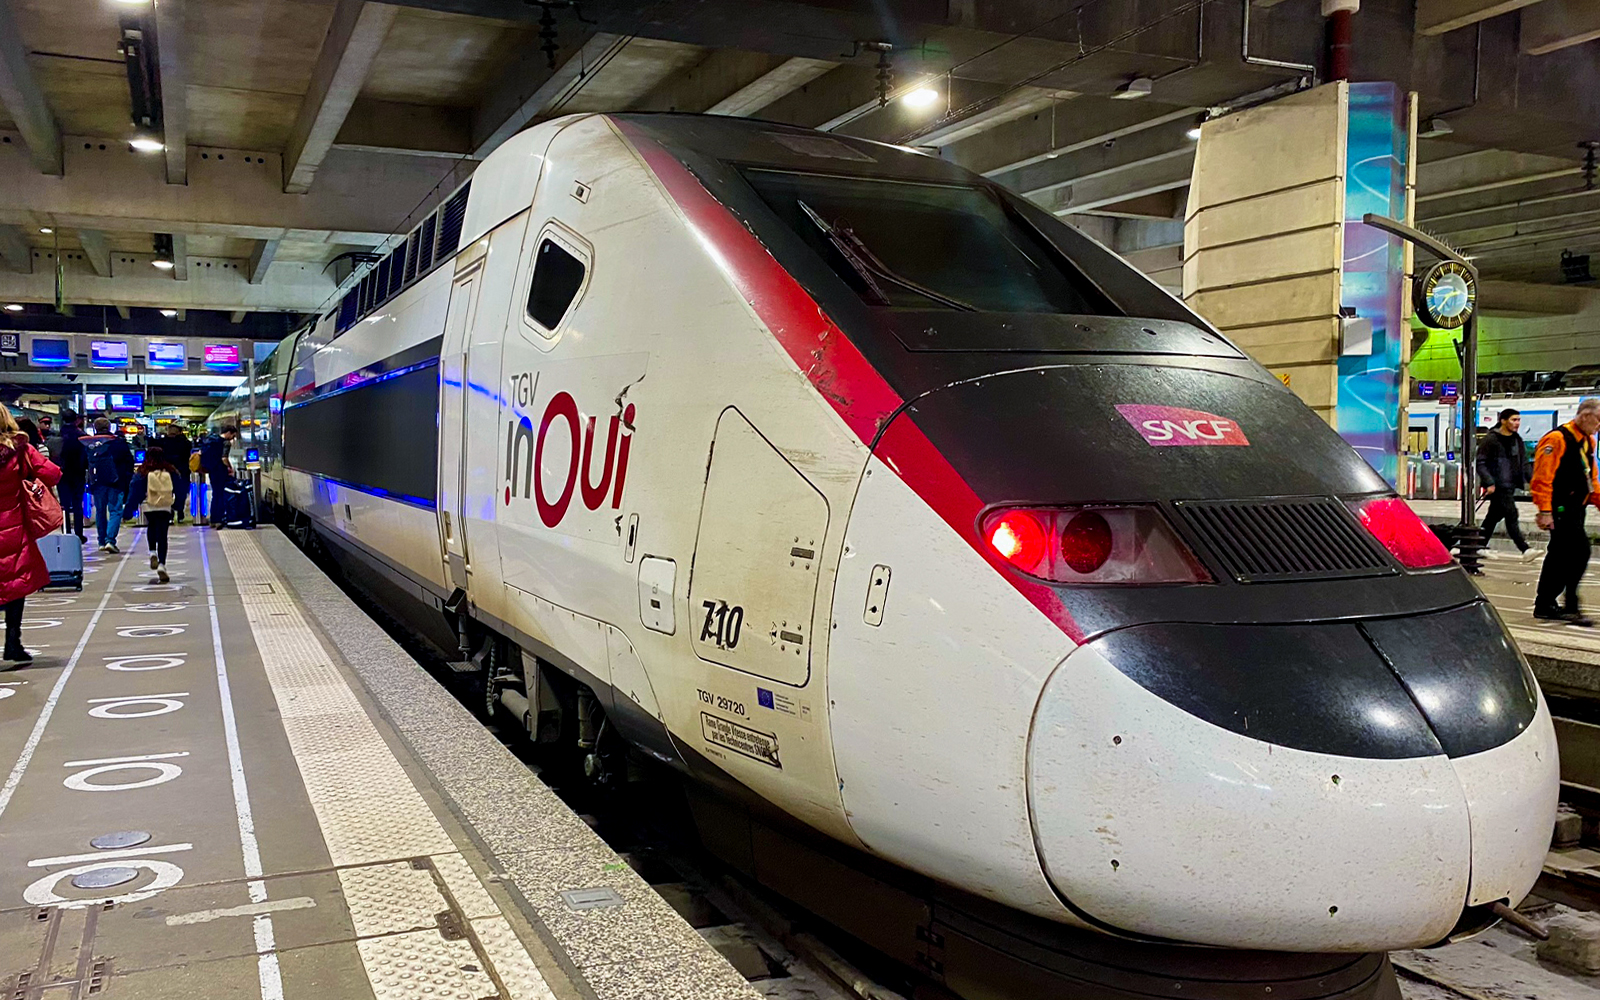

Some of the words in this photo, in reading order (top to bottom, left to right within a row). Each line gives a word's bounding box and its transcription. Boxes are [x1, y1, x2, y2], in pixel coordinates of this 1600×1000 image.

[511, 371, 540, 408] TGV
[1142, 420, 1232, 441] SNCF
[700, 600, 743, 649] 710
[697, 689, 714, 705] TGV
[717, 696, 745, 716] 29720
